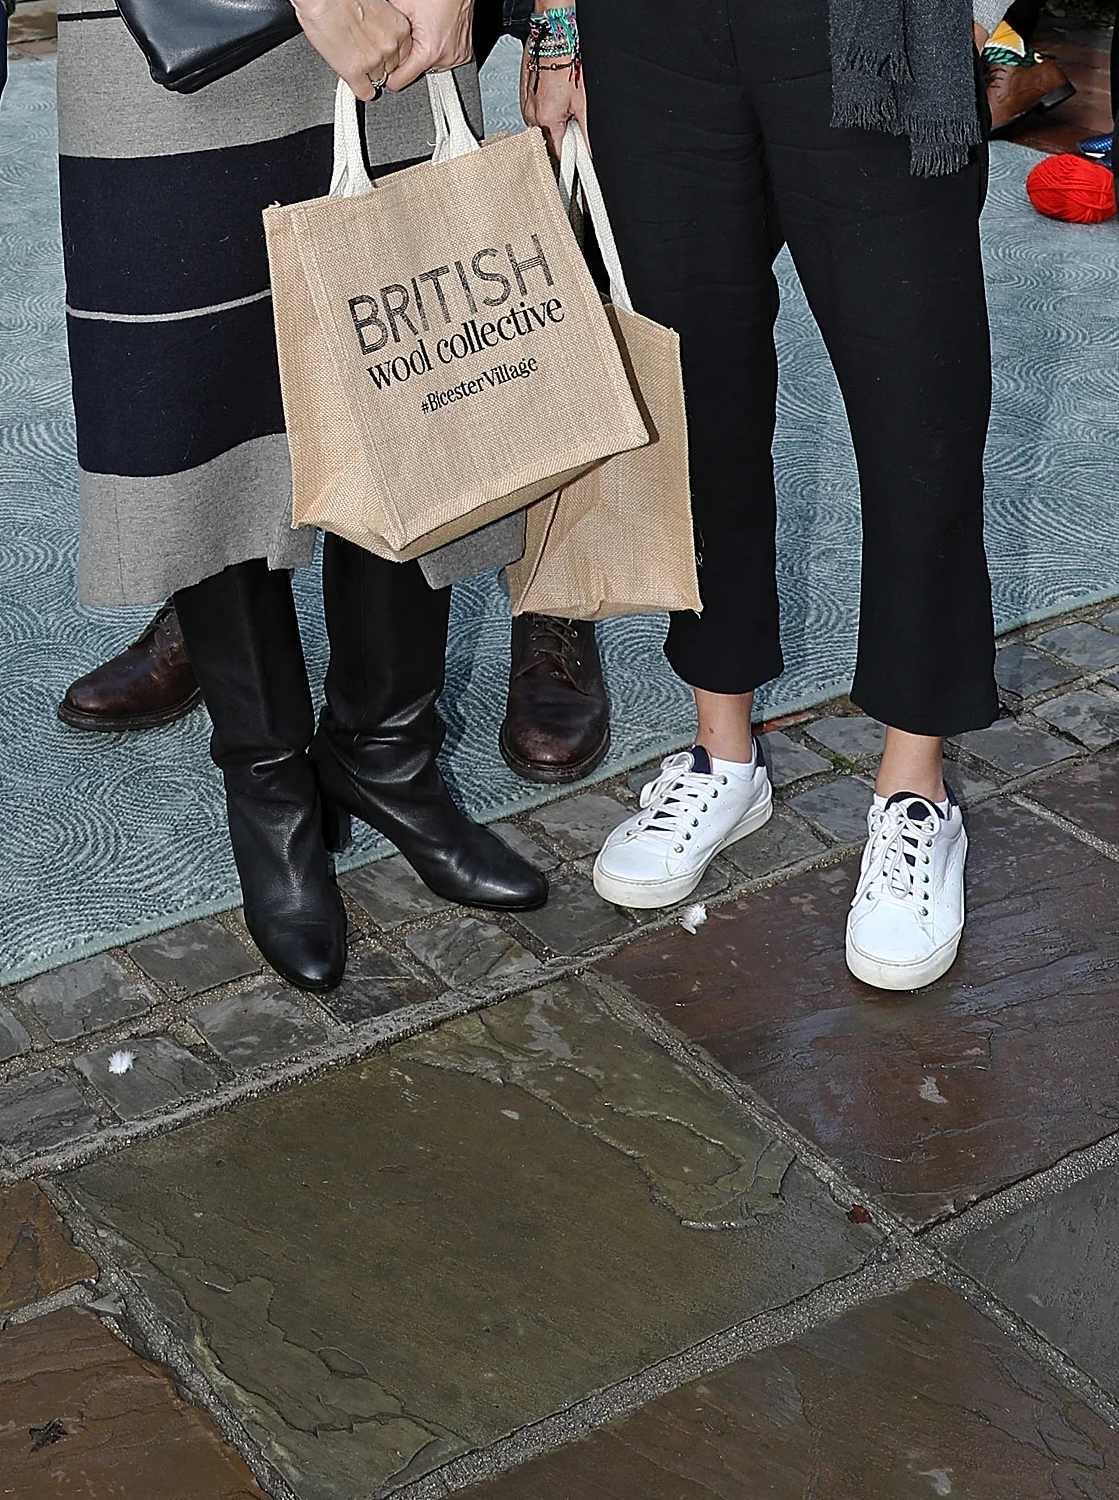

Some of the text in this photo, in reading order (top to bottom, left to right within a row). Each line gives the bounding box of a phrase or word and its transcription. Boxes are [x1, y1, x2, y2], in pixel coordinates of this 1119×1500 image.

[348, 234, 555, 355] BRITISH
[367, 297, 566, 390] wool collective
[421, 357, 538, 415] #BicesterVillage
